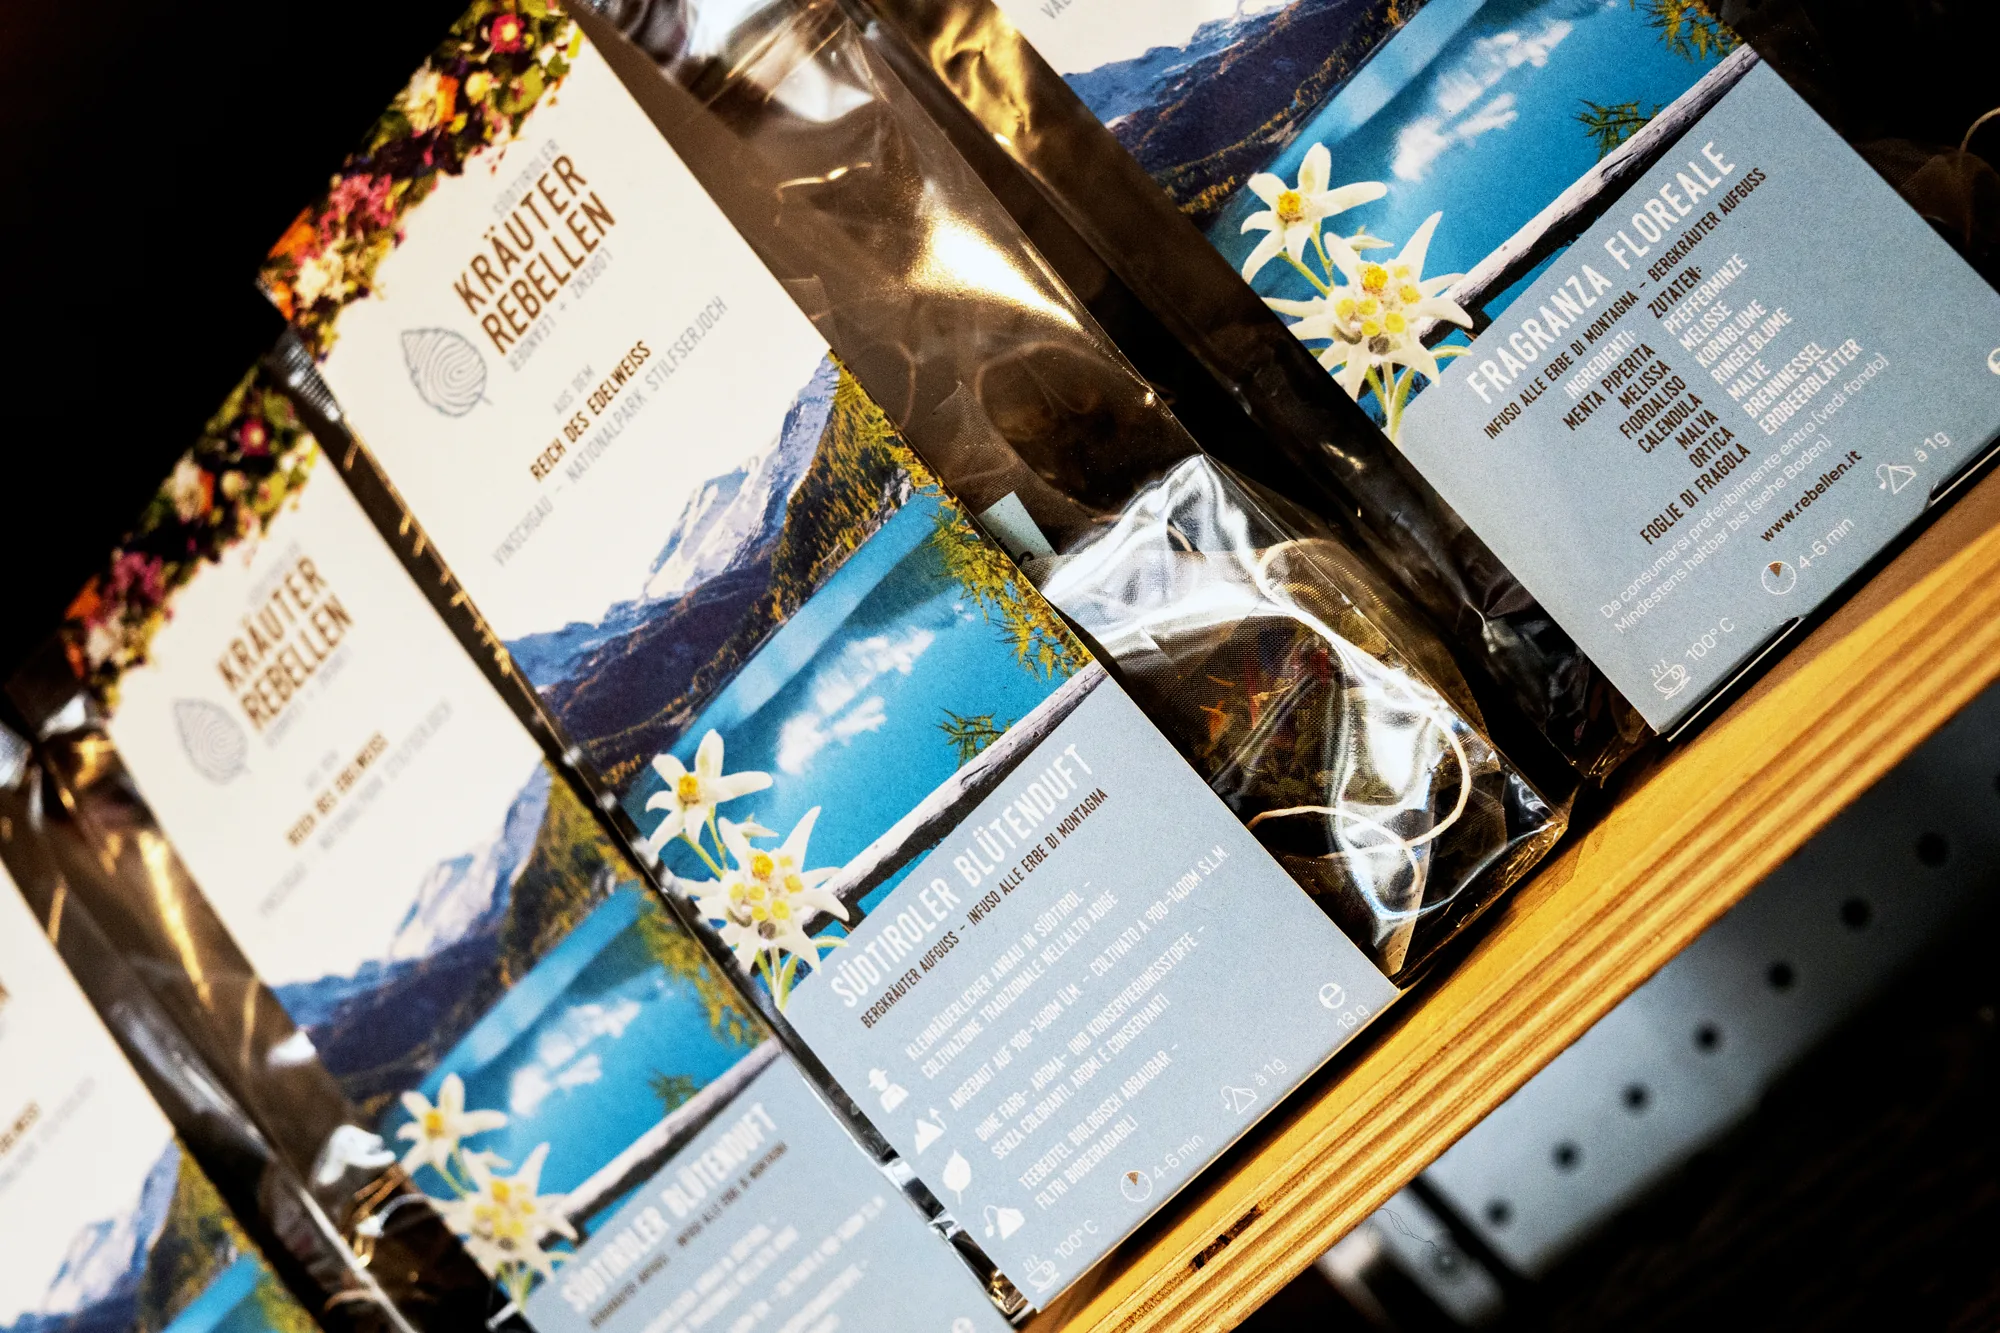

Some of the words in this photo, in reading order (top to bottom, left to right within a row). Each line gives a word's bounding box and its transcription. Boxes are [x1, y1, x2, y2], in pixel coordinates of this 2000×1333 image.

[453, 154, 588, 316] KRÄUTER
[481, 191, 616, 356] REBELLEN
[1464, 258, 1612, 408] FRAGRANZA
[1604, 141, 1735, 270] FLOREALE
[1484, 402, 1522, 439] INFUSO
[1519, 377, 1547, 407] ALLE
[1544, 351, 1574, 382] ERBE
[1570, 340, 1587, 356] DI
[1583, 291, 1639, 344] MONTAGNA
[1647, 211, 1721, 282] BERGKRÄUTER
[1718, 167, 1766, 216] AUFGUSS
[1647, 266, 1702, 319] ZUTATEN:
[1662, 253, 1748, 336] PFEFFERMINZE
[1679, 300, 1732, 352] MELISSE
[1695, 299, 1766, 368] KORNBLUME
[565, 388, 649, 485] NATIONALPARK
[645, 295, 729, 393] STILFSERJOCH
[1563, 330, 1635, 400] INGREDIENTI:
[1563, 391, 1606, 431] MENTA
[1601, 343, 1656, 394] PIPERITA
[1618, 360, 1671, 409] MELISSA
[1710, 307, 1792, 385] RINGELBLUME
[1726, 359, 1770, 402] MALVE
[1742, 339, 1827, 423] BRENNNESSEL
[1758, 330, 1862, 436] ERDBEERBLÄTTER
[529, 437, 568, 484] REICH
[563, 411, 590, 445] DES
[586, 340, 652, 416] EDELWEISS
[1619, 375, 1686, 439] FIORDALISO
[1638, 393, 1703, 453] CALENDULA
[1675, 410, 1719, 450] MALVA
[1689, 426, 1735, 468] ORTICA
[1924, 431, 1951, 450] 1g
[1599, 596, 1623, 618] Da
[1620, 535, 1691, 606] consumarsi
[1689, 446, 1781, 546] preferibilmente
[1780, 422, 1816, 456] entro
[1640, 502, 1684, 545] FOGLIE
[1679, 489, 1699, 508] DI
[1694, 443, 1751, 495] FRAGOLA
[1761, 450, 1863, 542] www.rebellen.it
[1614, 568, 1688, 638] Mindestens
[1682, 528, 1728, 571] haltbar
[1726, 511, 1749, 531] bis
[1799, 540, 1827, 569] 4-6
[1825, 518, 1854, 545] min
[240, 594, 354, 733] REBELLEN
[831, 878, 961, 1008] SÜDTIROLER
[953, 743, 1092, 887] BLÜTENDUFT
[860, 968, 922, 1029] BERGKRÄUTER
[919, 930, 959, 973] AUFGUSS
[967, 890, 1001, 926] INFUSO
[999, 867, 1025, 896] ALLE
[1021, 844, 1048, 873] ERBE
[1044, 833, 1060, 850] DI
[1056, 788, 1108, 838] MONTAGNA
[905, 974, 993, 1061] KLEINBÄUERLICHER
[990, 943, 1025, 981] ANBAU
[1021, 932, 1038, 950] IN
[1034, 890, 1084, 937] SÜDTIROL
[921, 1017, 984, 1079] COLTIVAZIONE
[979, 959, 1045, 1023] TRADIZIONALE
[1040, 916, 1090, 966] NELL'ALTO
[1087, 889, 1118, 923] ADIGE
[949, 1062, 995, 1111] ANGEBAUT
[992, 1045, 1013, 1070] AUF
[1089, 927, 1141, 977] COLTIVATO
[1137, 919, 1150, 934] A
[975, 1113, 1003, 1141] OHNE
[1067, 1031, 1091, 1055] UND
[1086, 932, 1198, 1038] KONSERVIERUNGSSTOFFE
[991, 1128, 1026, 1160] SENZA
[1070, 1055, 1103, 1089] AROMI
[1097, 1047, 1111, 1063] E
[1105, 992, 1170, 1055] CONSERVANTI
[1263, 1058, 1287, 1075] 1g
[1018, 1142, 1073, 1190] TEEBEUTEL
[1067, 1093, 1124, 1147] BIOLOGISCH
[1120, 1050, 1172, 1100] ABBAUBAR
[1035, 1178, 1068, 1210] FILTRI
[1063, 1114, 1138, 1184] BIODEGRADABILI
[1154, 1153, 1180, 1179] 4-6
[1177, 1135, 1204, 1159] min
